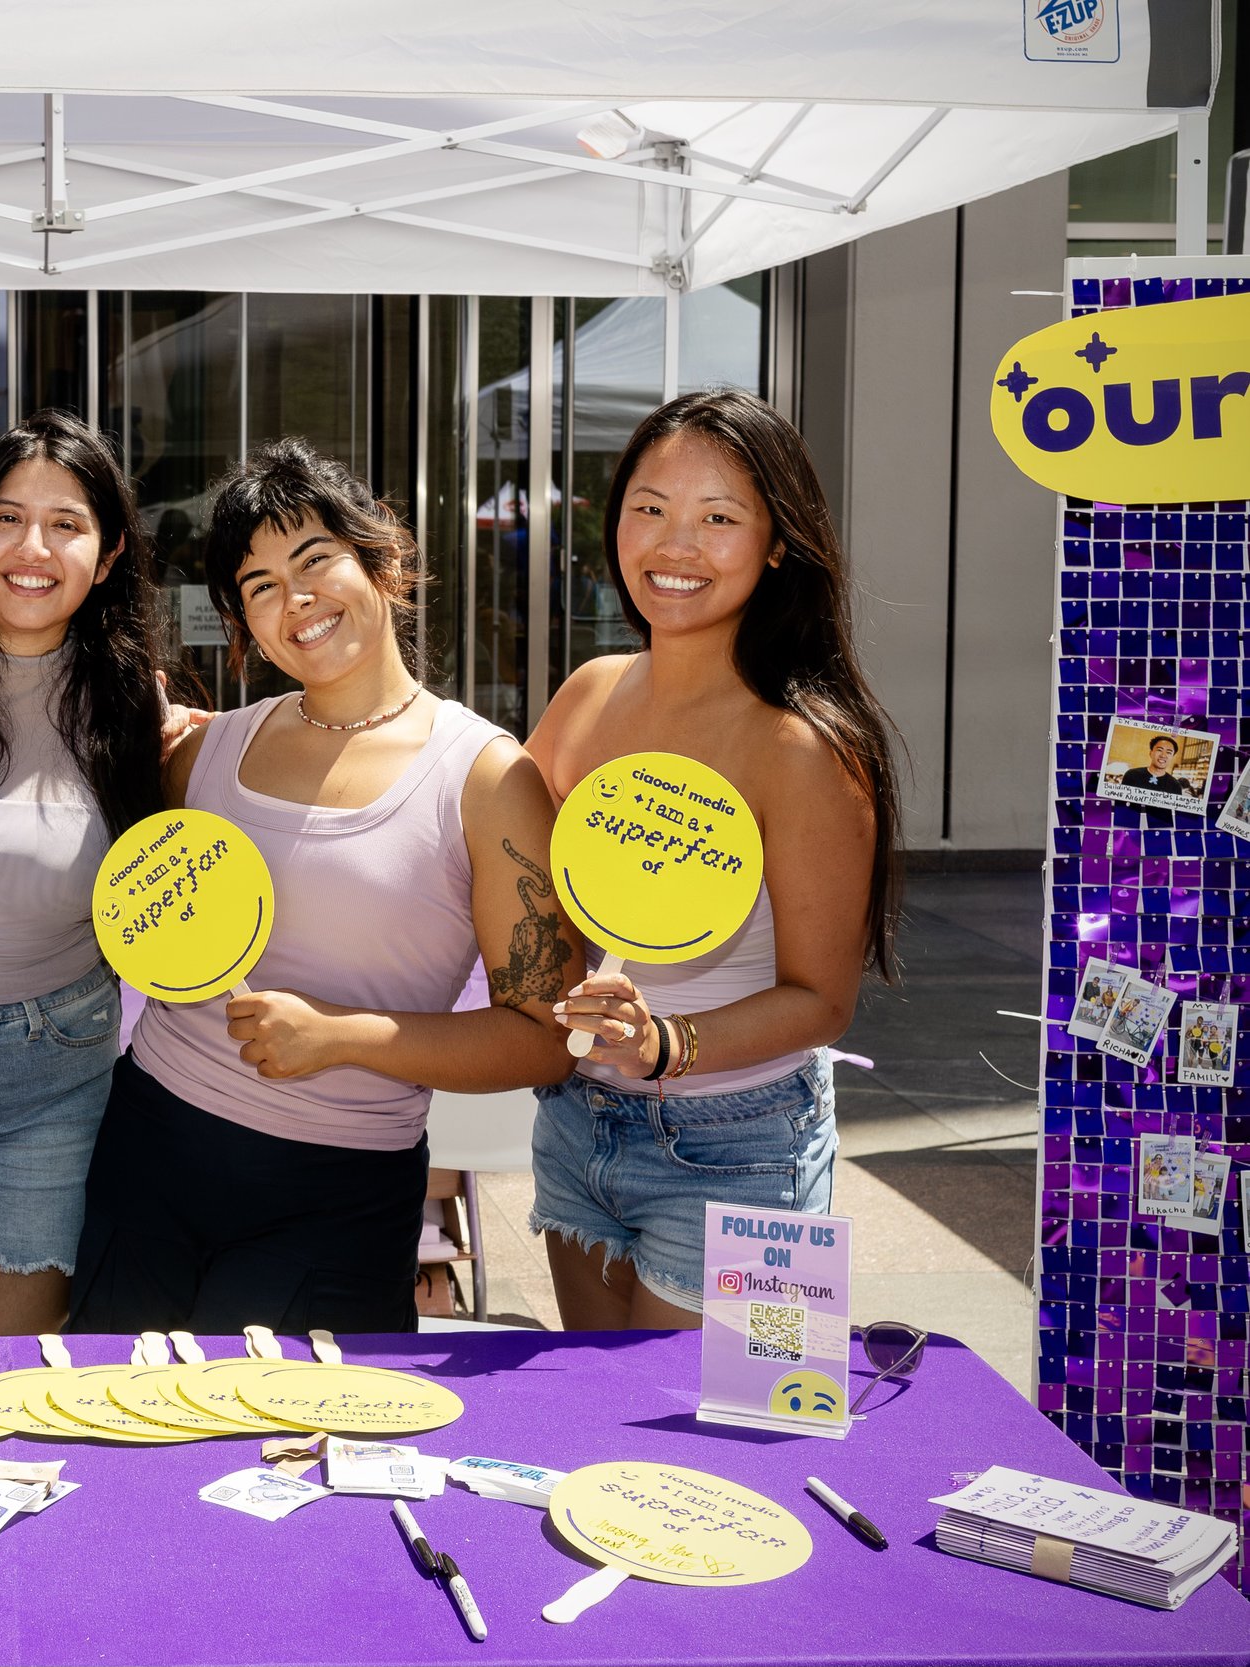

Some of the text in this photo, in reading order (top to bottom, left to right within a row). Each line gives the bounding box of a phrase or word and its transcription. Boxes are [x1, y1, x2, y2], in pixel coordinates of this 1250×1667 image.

[1022, 371, 1250, 453] our
[632, 768, 736, 816] ciaooo! media
[645, 797, 699, 832] I am a
[109, 820, 185, 887] ciaooo! media
[585, 810, 743, 874] superfan
[136, 855, 181, 893] I am a
[641, 859, 665, 875] of
[122, 839, 229, 945] superfan
[180, 902, 196, 922] of
[1192, 1002, 1212, 1010] MY
[1182, 1070, 1222, 1082] FAMILY
[1145, 1206, 1187, 1215] Pikachu
[722, 1215, 835, 1247] FOLLOW US
[763, 1247, 791, 1268] ON
[744, 1272, 836, 1303] Instagram
[268, 1397, 435, 1409] superfan
[659, 1471, 781, 1519] ciaooo! media
[980, 1485, 997, 1495] to
[1019, 1485, 1042, 1495] a
[600, 1483, 787, 1548] superfan
[671, 1490, 736, 1518] I am a
[1119, 1505, 1136, 1516] to
[662, 1522, 690, 1533] of
[1160, 1515, 1191, 1542] media
[667, 1543, 698, 1558] the
